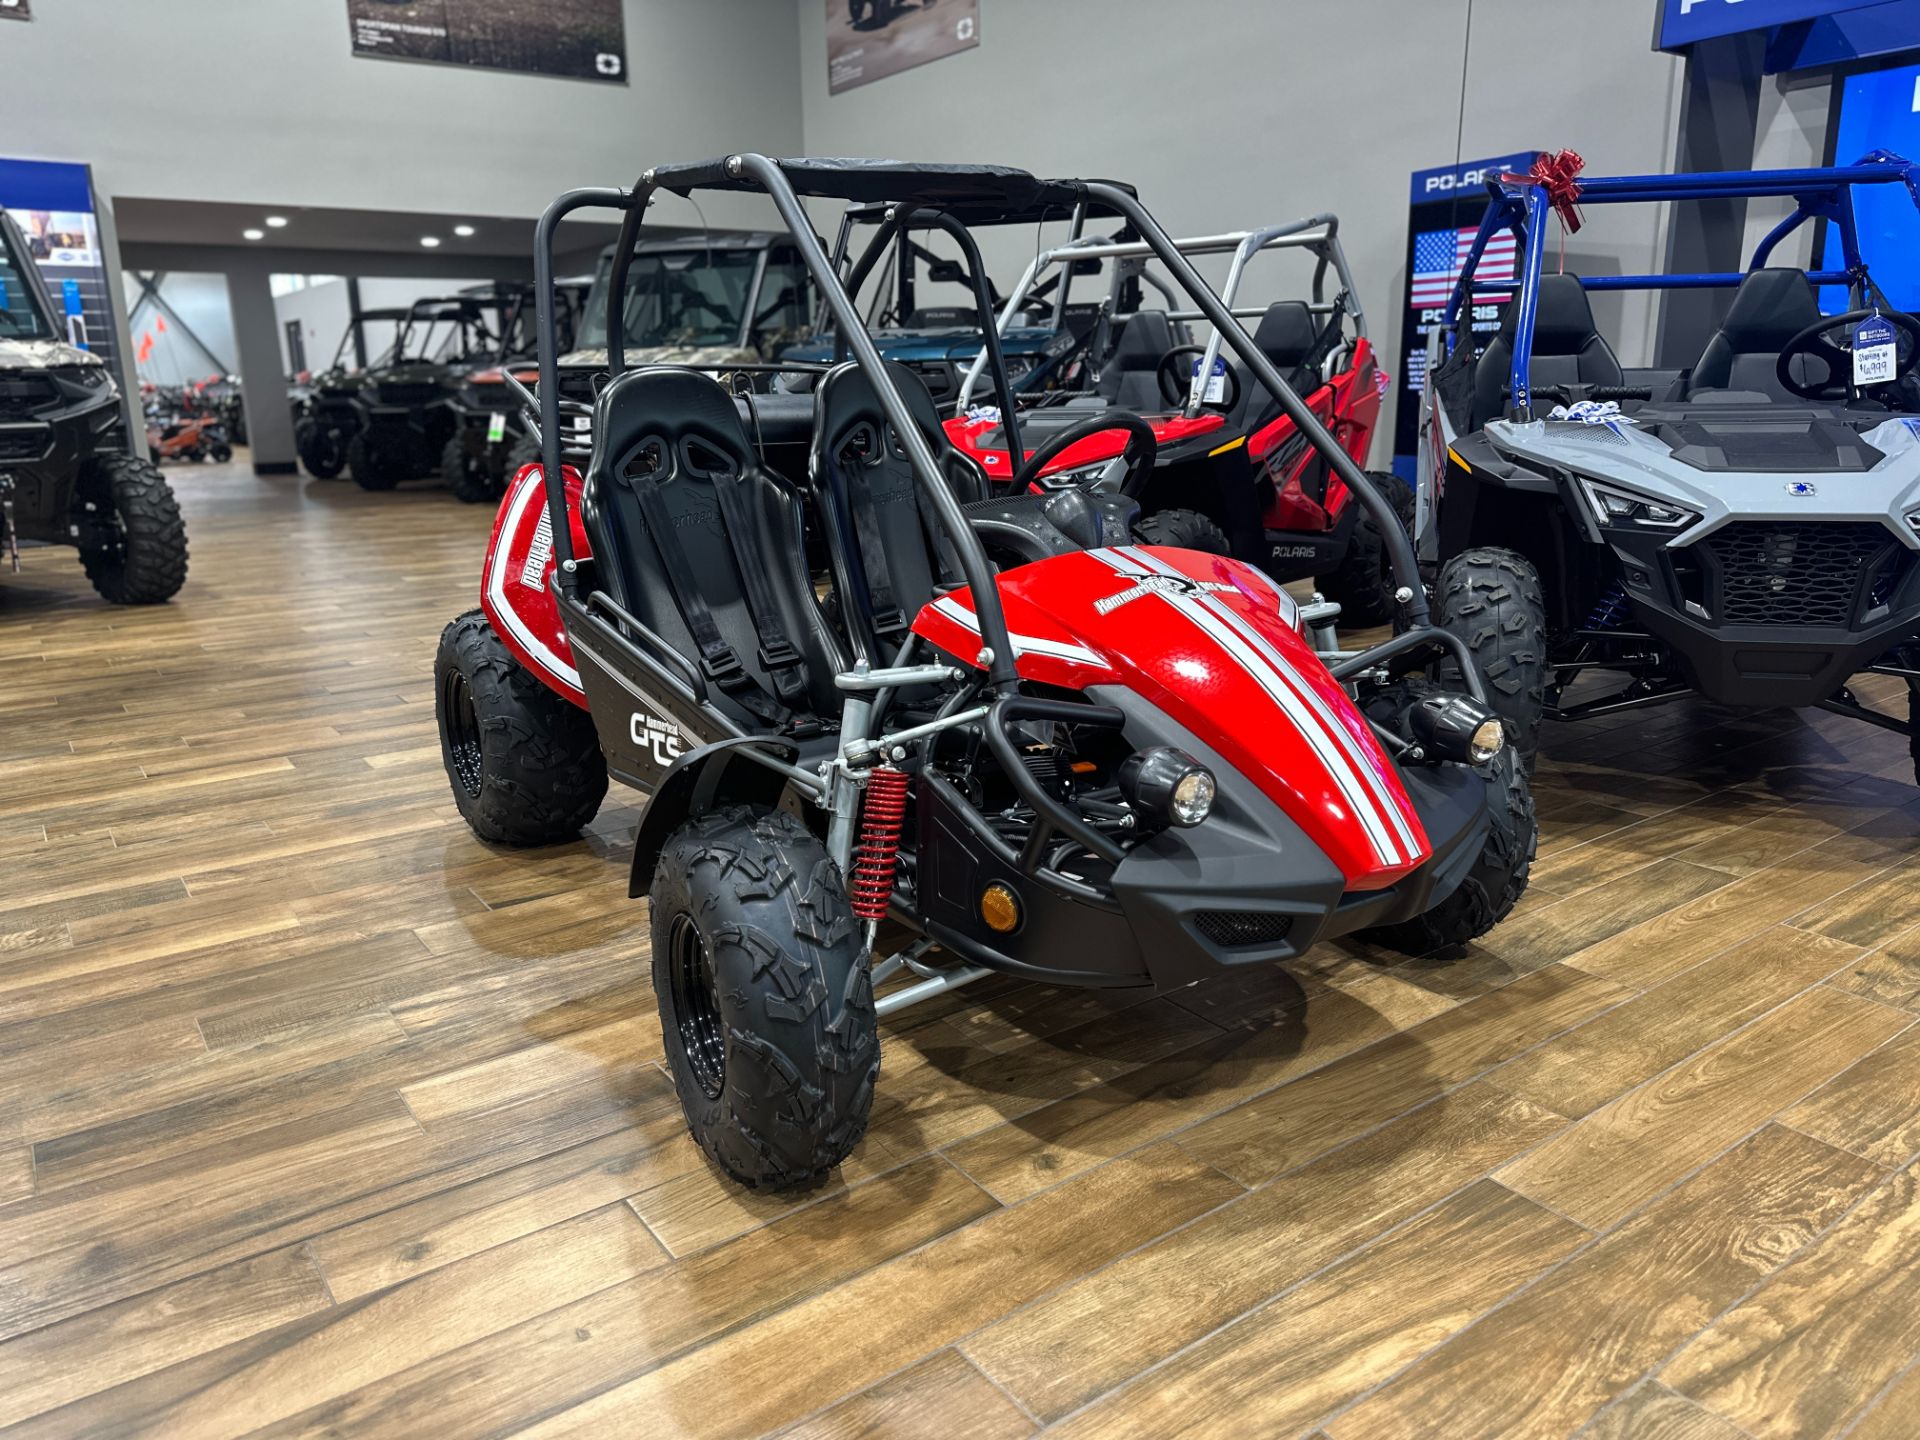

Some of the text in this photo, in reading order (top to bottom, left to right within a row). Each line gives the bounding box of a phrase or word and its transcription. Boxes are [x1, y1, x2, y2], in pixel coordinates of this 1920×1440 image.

[1421, 305, 1498, 324] PORIS
[1858, 351, 1880, 362] Starting
[1272, 546, 1316, 558] POLARIS
[1093, 574, 1173, 616] Hammerhead
[646, 715, 679, 736] Hammerhead
[630, 712, 686, 767] GTS
